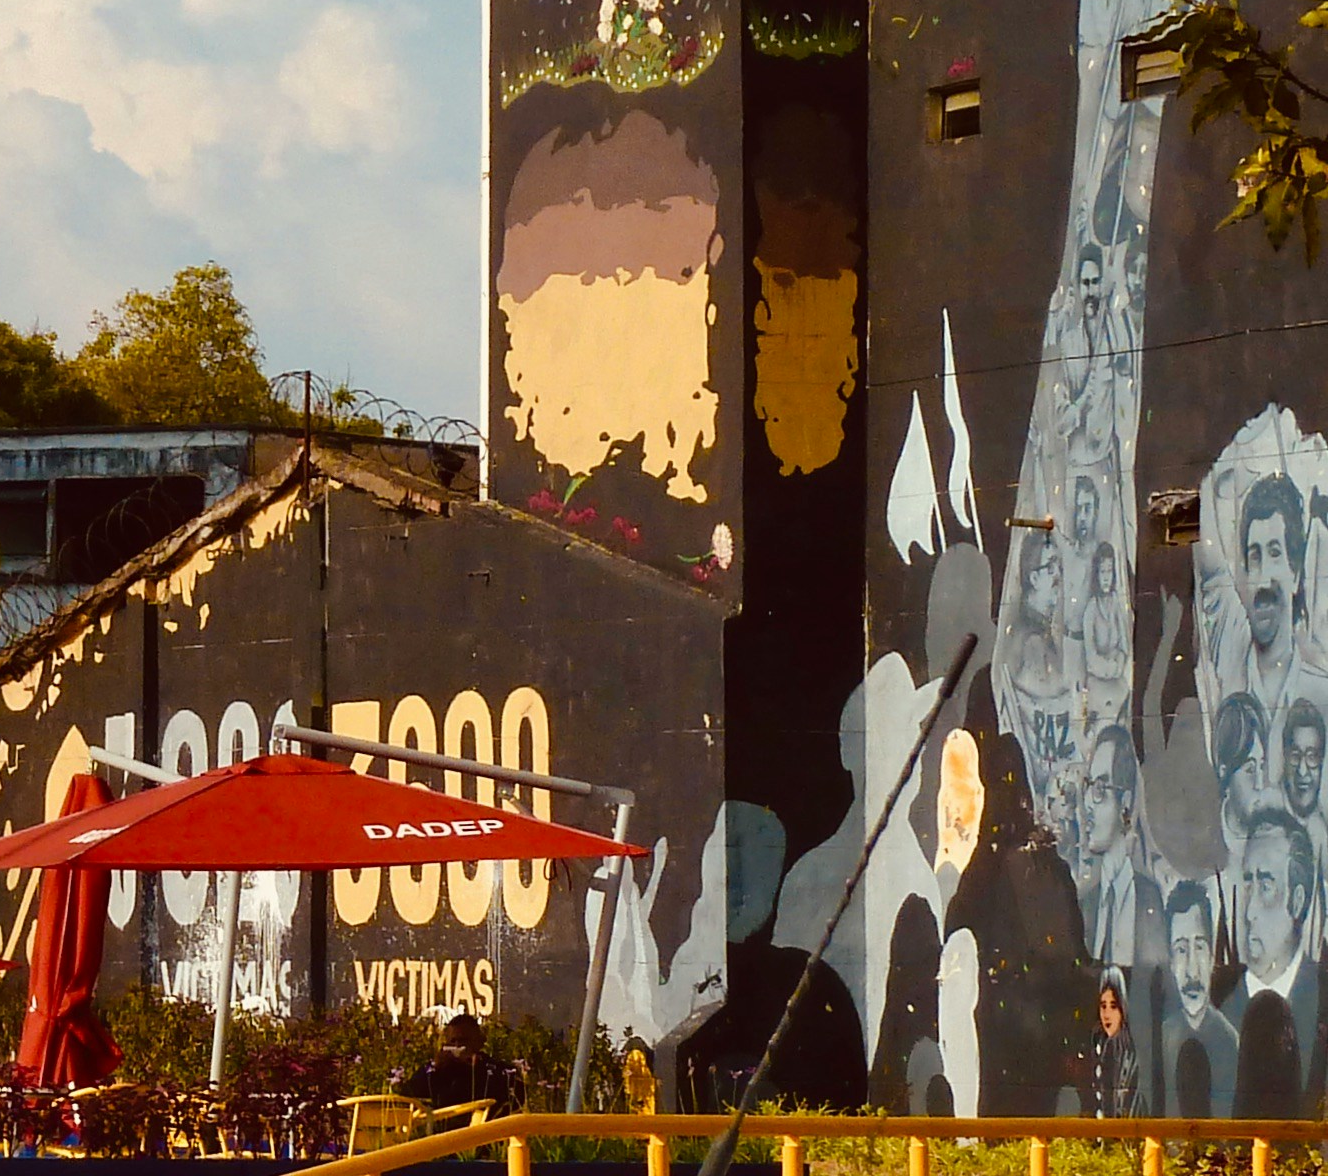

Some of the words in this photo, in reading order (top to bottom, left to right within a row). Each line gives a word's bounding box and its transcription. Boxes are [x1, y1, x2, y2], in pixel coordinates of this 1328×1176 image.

[1033, 709, 1076, 762] PAZ
[362, 819, 504, 839] DADEP
[354, 958, 494, 1018] VICTIMAS
